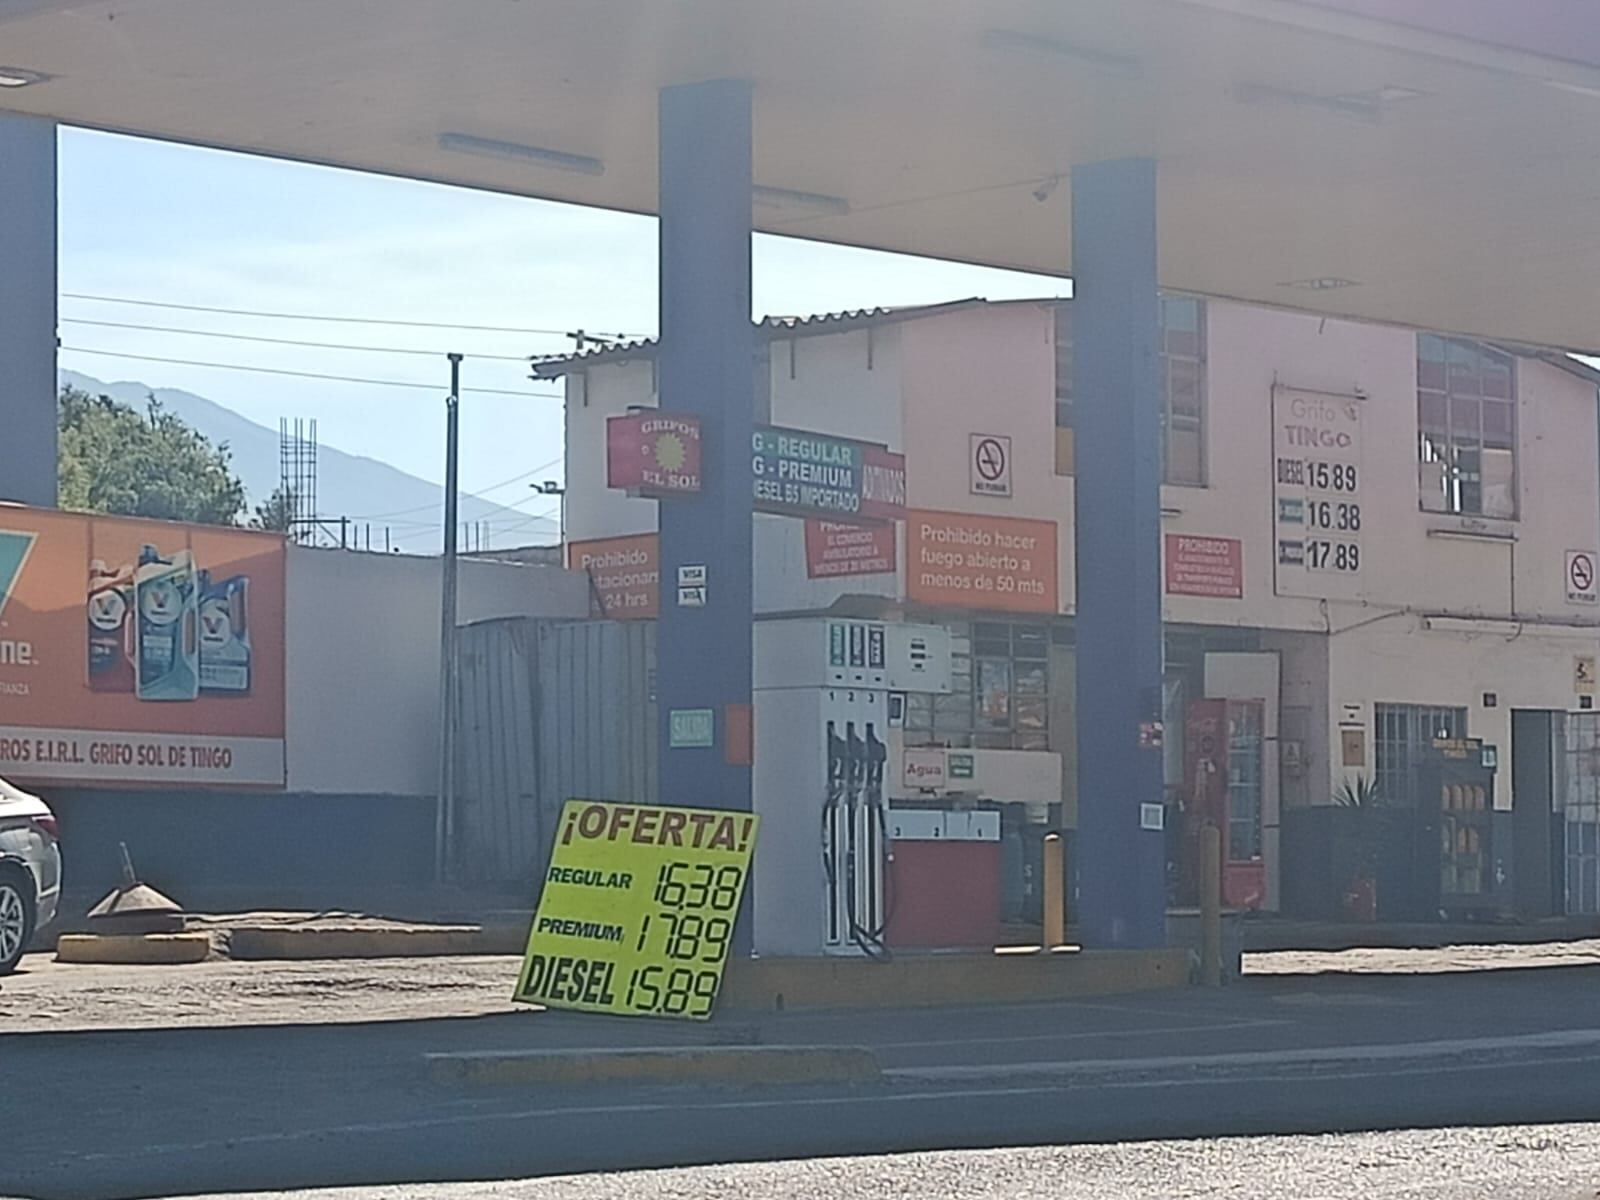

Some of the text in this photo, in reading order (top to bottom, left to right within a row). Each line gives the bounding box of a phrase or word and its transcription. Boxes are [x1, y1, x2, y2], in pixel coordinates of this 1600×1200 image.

[1291, 399, 1335, 421] Grifo
[1285, 425, 1351, 448] TINGO
[778, 437, 852, 466] REGULAR
[642, 470, 699, 489] EL SOL
[752, 456, 765, 475] G
[779, 460, 852, 489] PREMIUM
[752, 479, 783, 501] IESEL
[800, 487, 860, 512] IMPORTADO
[921, 524, 1036, 549] Prohibido hacer
[582, 550, 648, 569] Prohibido
[921, 547, 1031, 571] fuego abierto a
[921, 572, 1045, 595] menos de 50 mts
[605, 592, 648, 609] 24 hrs
[848, 691, 854, 702] 2
[868, 693, 875, 703] 3
[36, 740, 84, 763] E.I.R.L.
[90, 743, 133, 765] GRIFO
[137, 744, 164, 766] SOL
[168, 746, 186, 767] DE
[190, 747, 232, 769] TINGO
[907, 763, 942, 776] Agua
[562, 805, 753, 852] ¡OFERTA!
[549, 862, 742, 911] REGULAR 16.38
[537, 913, 731, 963] PREMIUM 17.89
[522, 955, 719, 1016] DIESEL 15.89
